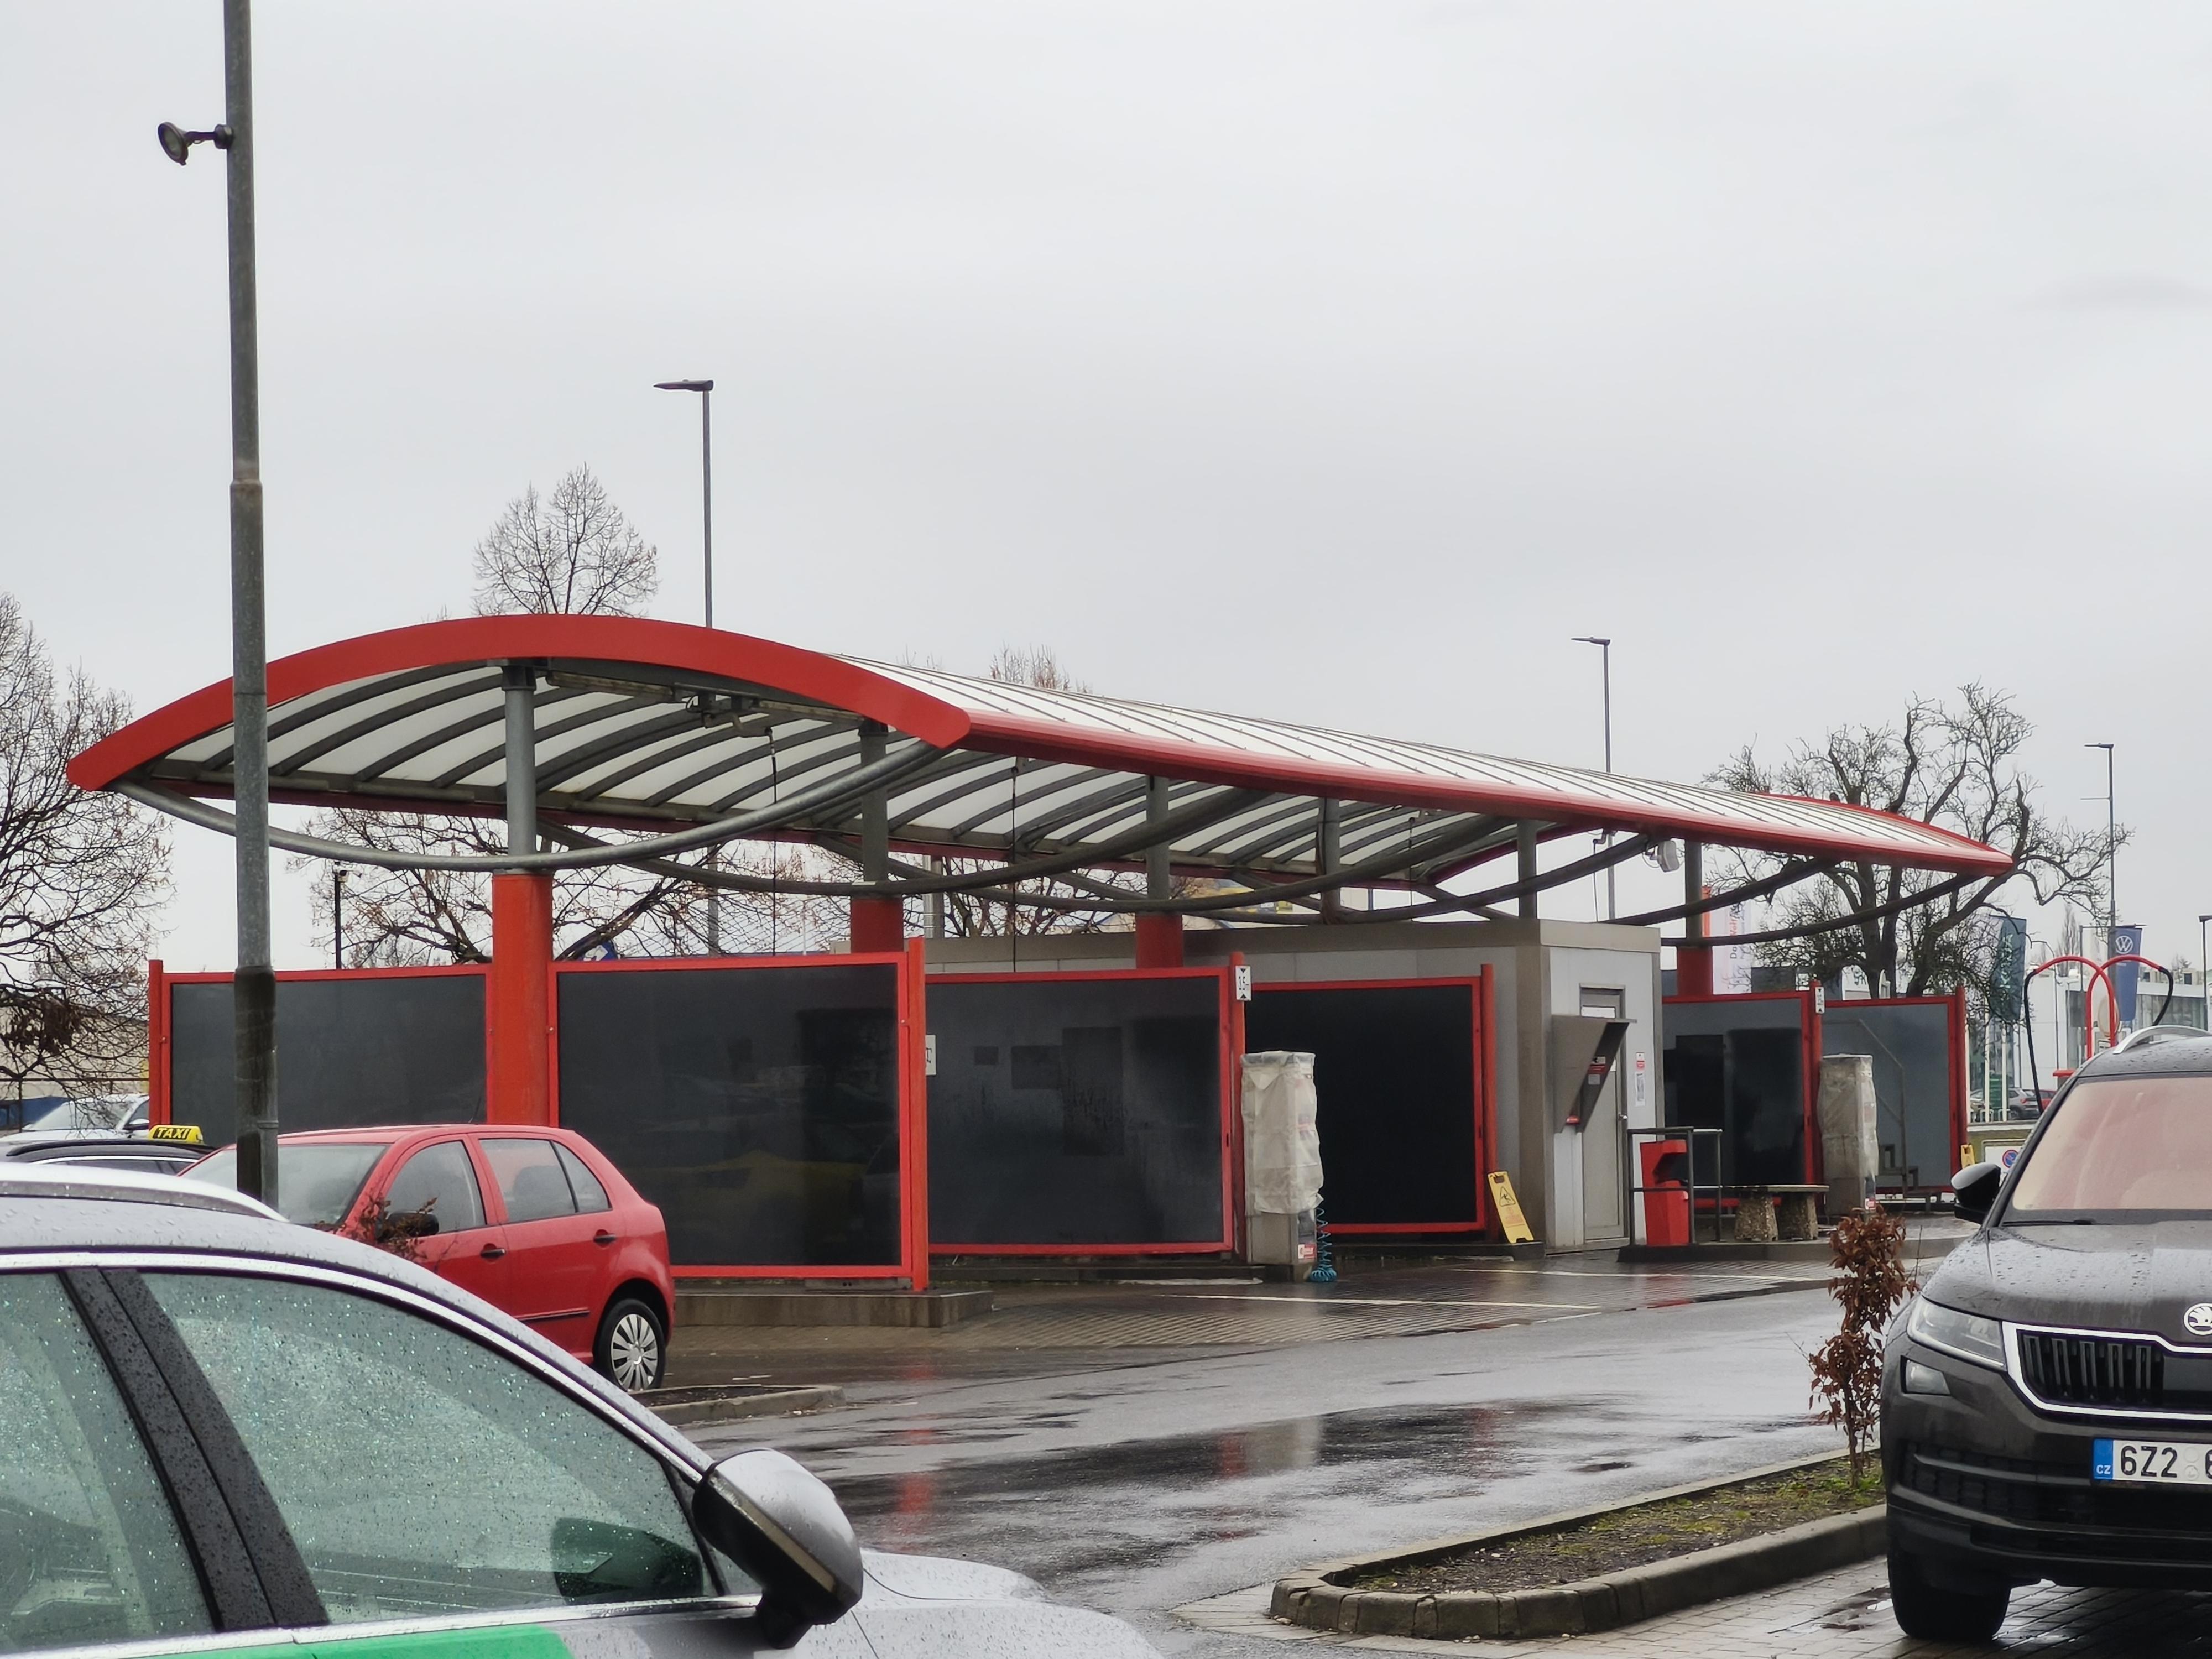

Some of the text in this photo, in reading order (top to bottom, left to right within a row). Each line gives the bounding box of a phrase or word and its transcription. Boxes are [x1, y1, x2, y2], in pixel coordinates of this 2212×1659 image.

[2116, 936, 2133, 954] VW
[157, 1128, 189, 1139] TAXI
[2121, 1445, 2178, 1478] 6Z2
[2096, 1464, 2111, 1474] CZ
